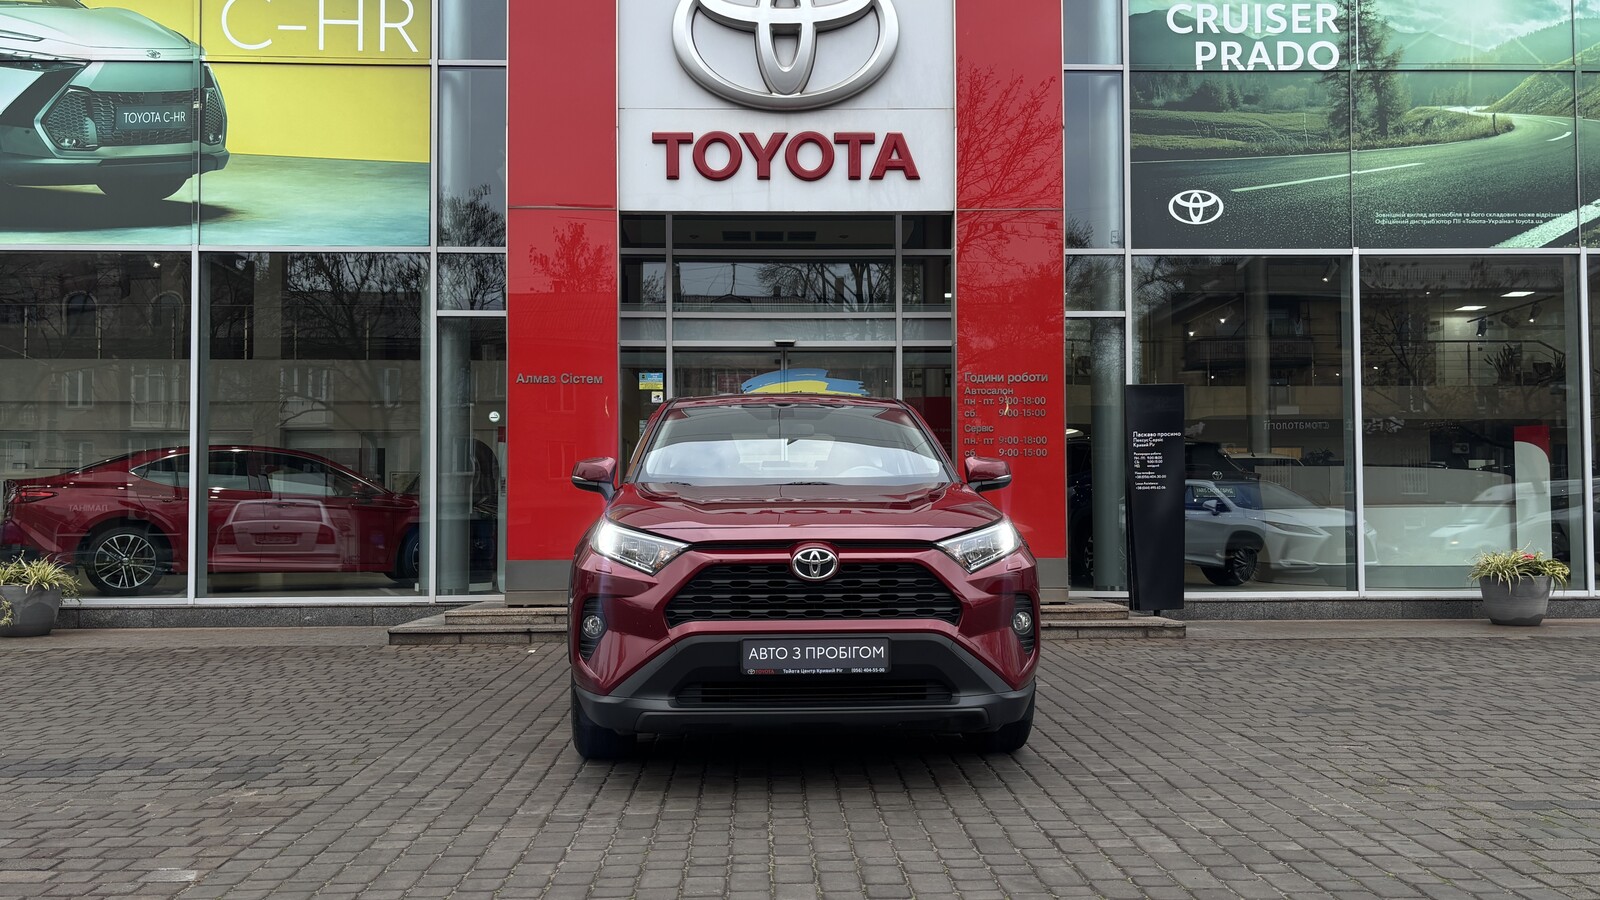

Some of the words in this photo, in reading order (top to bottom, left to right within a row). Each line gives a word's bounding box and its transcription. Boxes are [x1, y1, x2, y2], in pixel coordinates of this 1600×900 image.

[1166, 3, 1340, 35] CRUISER
[220, 0, 419, 53] C-HR
[1195, 41, 1340, 71] PRADO
[123, 111, 160, 123] TOYOTA
[162, 111, 187, 123] C-HR
[651, 131, 921, 181] TOYOTA
[1471, 211, 1485, 219] його
[516, 373, 557, 384] Алмаз
[560, 373, 603, 384] Сістем
[964, 372, 1004, 383] Години
[1008, 372, 1048, 384] роботи
[964, 386, 1014, 395] Автосалон
[964, 424, 994, 434] Сервіс
[748, 647, 788, 660] АВТО
[792, 647, 801, 659] З
[806, 646, 884, 659] ПРОБІГОМ
